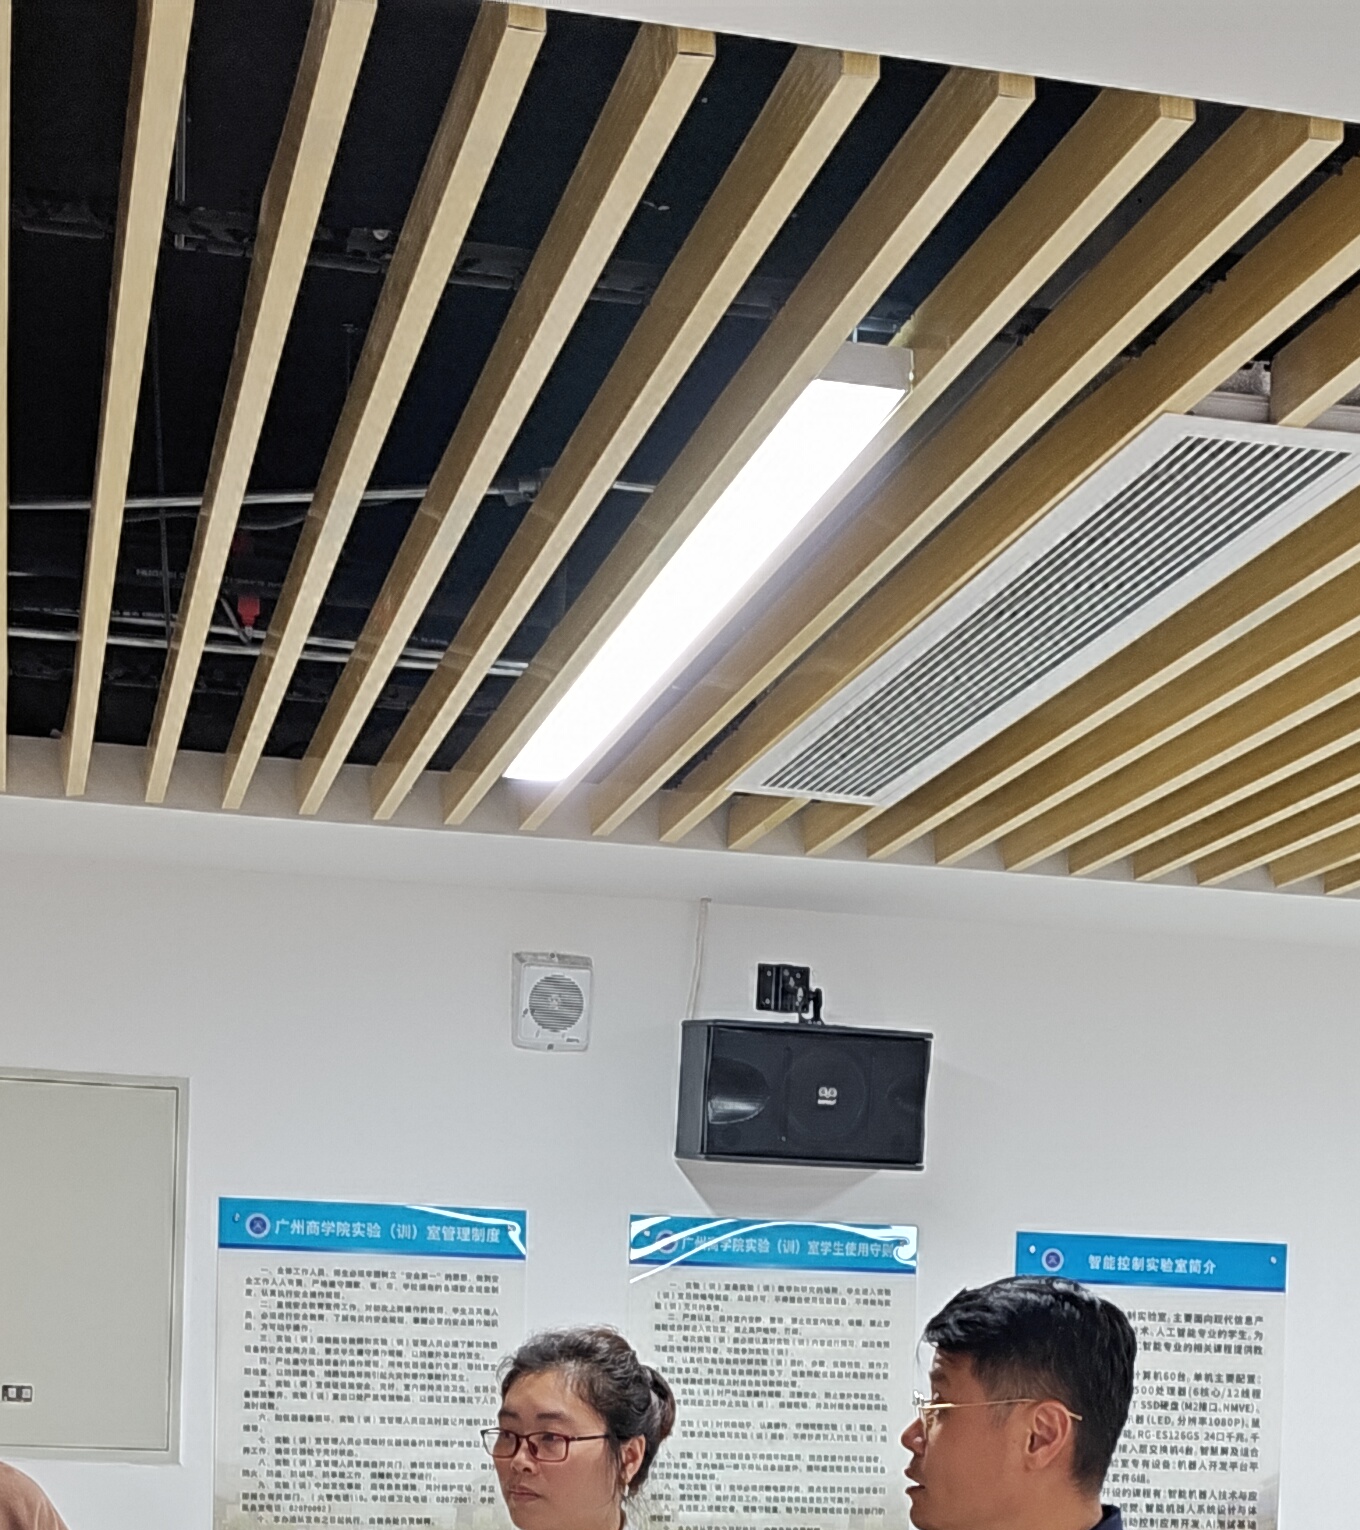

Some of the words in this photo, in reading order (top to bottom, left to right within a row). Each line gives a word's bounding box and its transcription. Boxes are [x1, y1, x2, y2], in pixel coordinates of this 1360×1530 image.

[1088, 1254, 1216, 1275] 智能控制实验室简介
[1134, 1326, 1263, 1341] 术、人工智能专业的学生。为
[1138, 1341, 1263, 1356] 智能专业的相关课程提供教
